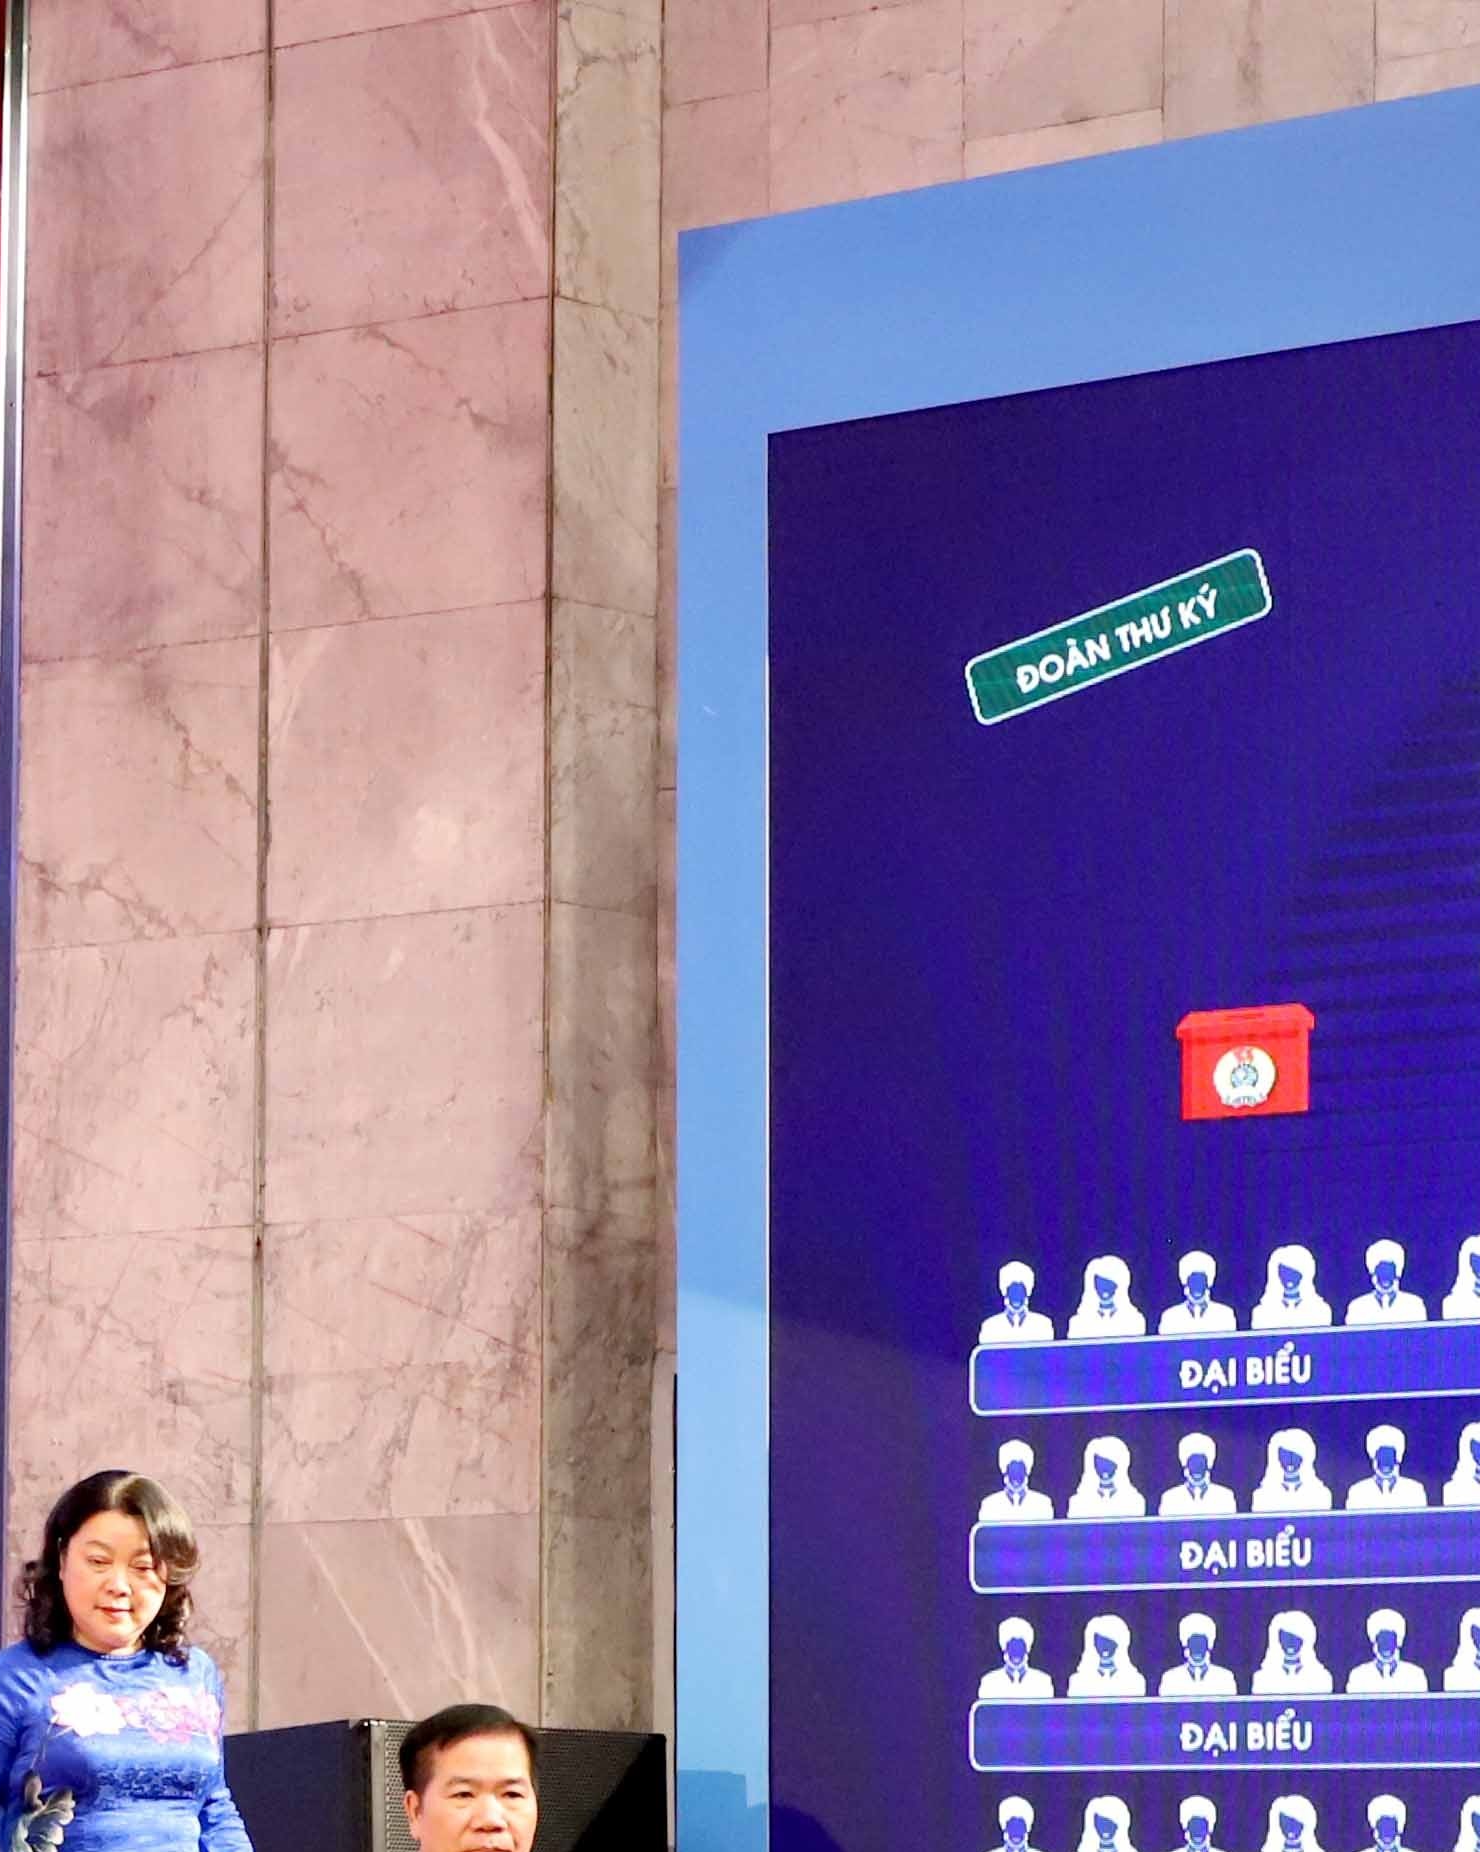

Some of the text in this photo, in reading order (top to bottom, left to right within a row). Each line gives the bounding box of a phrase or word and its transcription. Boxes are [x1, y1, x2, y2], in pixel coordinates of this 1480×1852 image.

[1015, 582, 1218, 694] ĐOÀN THƯ KÝ
[1179, 1342, 1312, 1394] ĐẠI BIỂU
[1179, 1525, 1312, 1575] ĐẠI BIỂU
[1179, 1707, 1313, 1757] ĐẠI BIỂU
